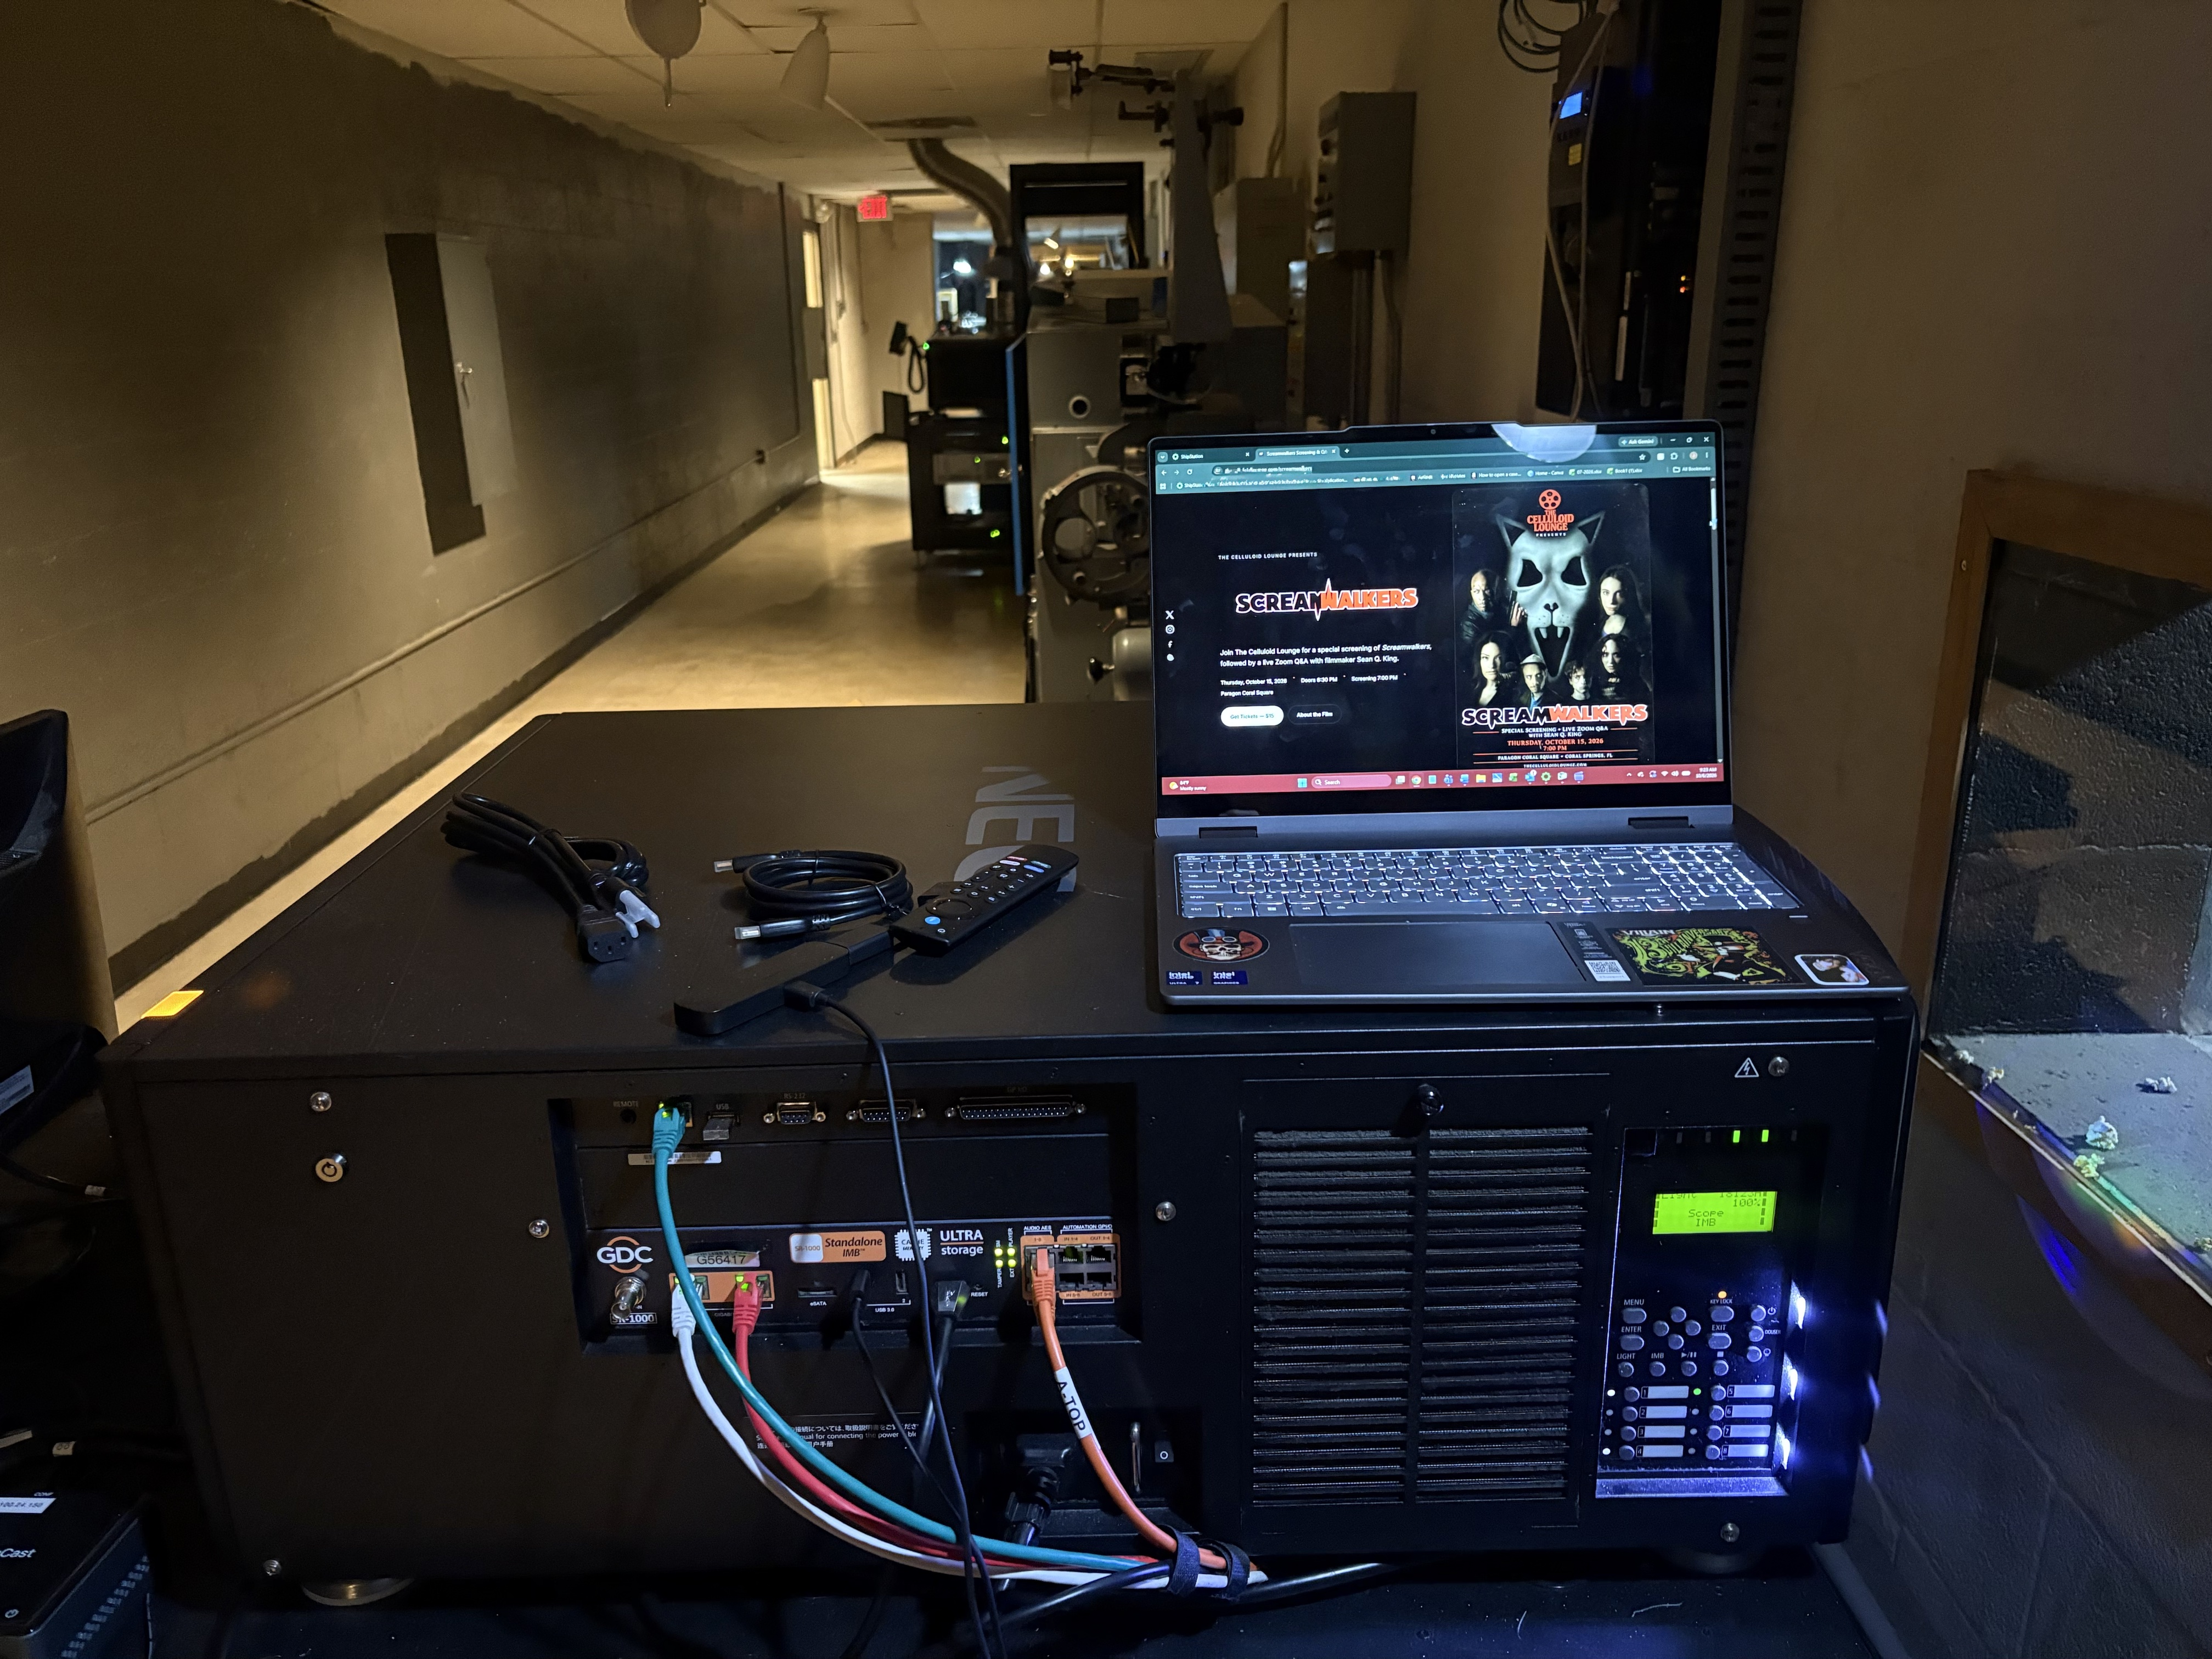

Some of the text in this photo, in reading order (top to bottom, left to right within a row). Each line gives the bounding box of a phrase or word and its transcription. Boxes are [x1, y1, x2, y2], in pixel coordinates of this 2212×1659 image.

[1527, 514, 1574, 524] CELLULOID
[1534, 522, 1568, 532] LOUNGE
[1235, 580, 1419, 620] SCREAMWALKERS
[1341, 645, 1372, 653] screening
[1382, 643, 1432, 651] Screamwalkers,
[1462, 703, 1649, 730] SCREAMWALKERS
[1733, 1198, 1760, 1207] 100%
[1688, 1209, 1724, 1218] Scope
[1696, 1218, 1716, 1227] IMB
[939, 1229, 983, 1241] ULTRA
[825, 1237, 882, 1247] Standalone
[596, 1246, 654, 1264] GDC
[941, 1246, 983, 1257] storage
[697, 1255, 746, 1264] G56417
[1055, 1381, 1086, 1431] A-TOP
[827, 1432, 864, 1440] connecting
